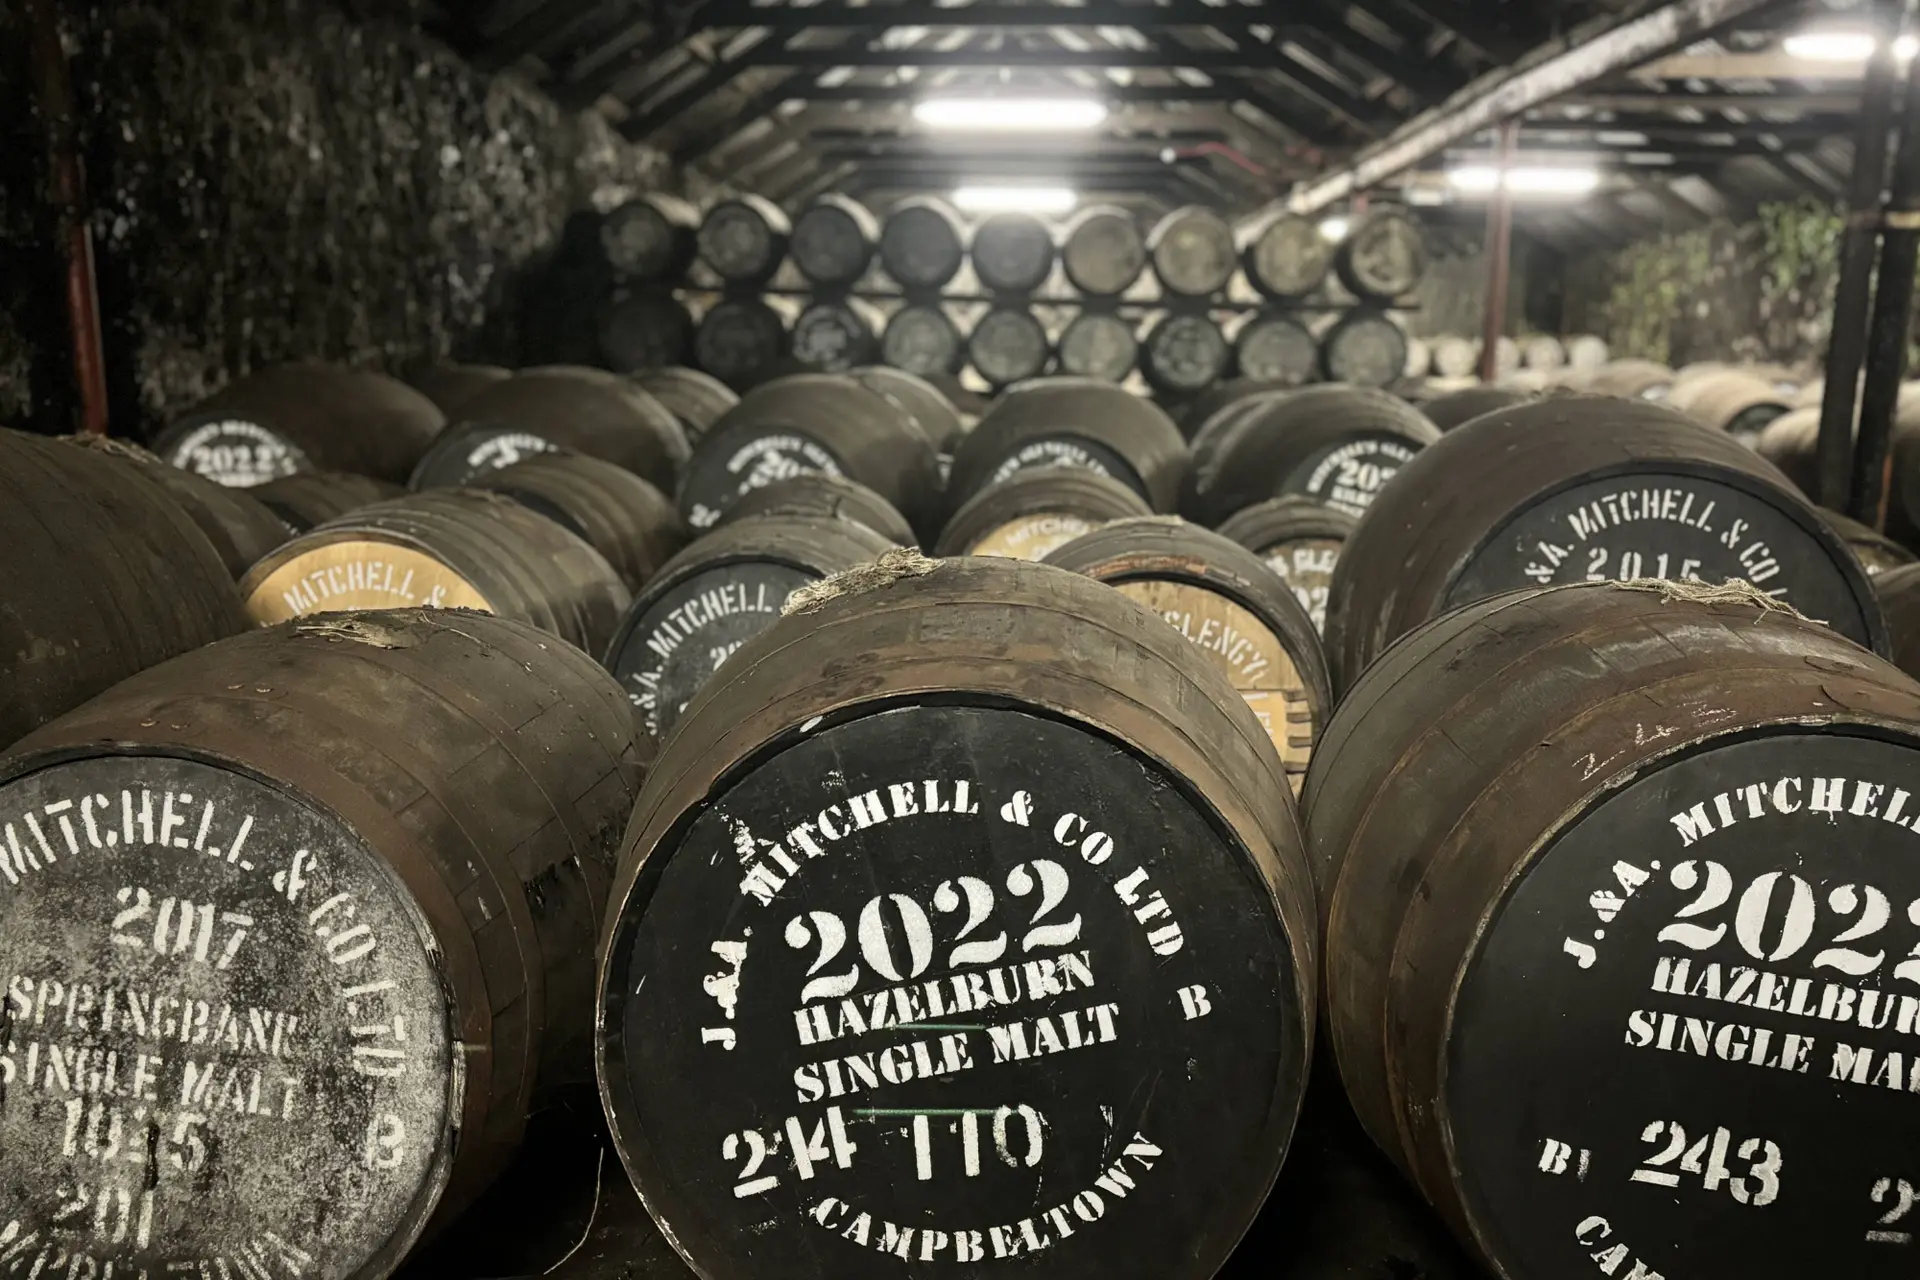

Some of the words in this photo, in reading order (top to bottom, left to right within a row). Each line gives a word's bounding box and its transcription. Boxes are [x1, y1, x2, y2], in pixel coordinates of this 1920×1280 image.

[1568, 488, 1713, 541] MITCHELL
[1720, 518, 1749, 549] &
[1739, 541, 1780, 583] CO
[1586, 547, 1702, 582] 2015
[283, 561, 415, 615] MITCHELL
[646, 583, 773, 659] MITCHELL
[1670, 777, 1920, 847] MITCHEL
[272, 850, 317, 901] &
[309, 892, 376, 965] CO
[739, 779, 979, 907] MITCHELL
[1000, 790, 1034, 826] &
[1053, 813, 1114, 865] CO
[1113, 866, 1184, 956] LTD
[111, 887, 254, 970] 2017
[784, 859, 1082, 1004] 2022
[793, 950, 1095, 1046] HAZELBURN
[1176, 984, 1212, 1020] B
[793, 1032, 974, 1103] SINGLE
[986, 1003, 1120, 1064] MALT
[1625, 1009, 1815, 1073] SINGLE
[180, 1060, 303, 1121] MALT
[812, 1132, 1163, 1263] CAMPBELTOWN
[1629, 1120, 1783, 1207] 243
[1865, 1177, 1920, 1244] 2
